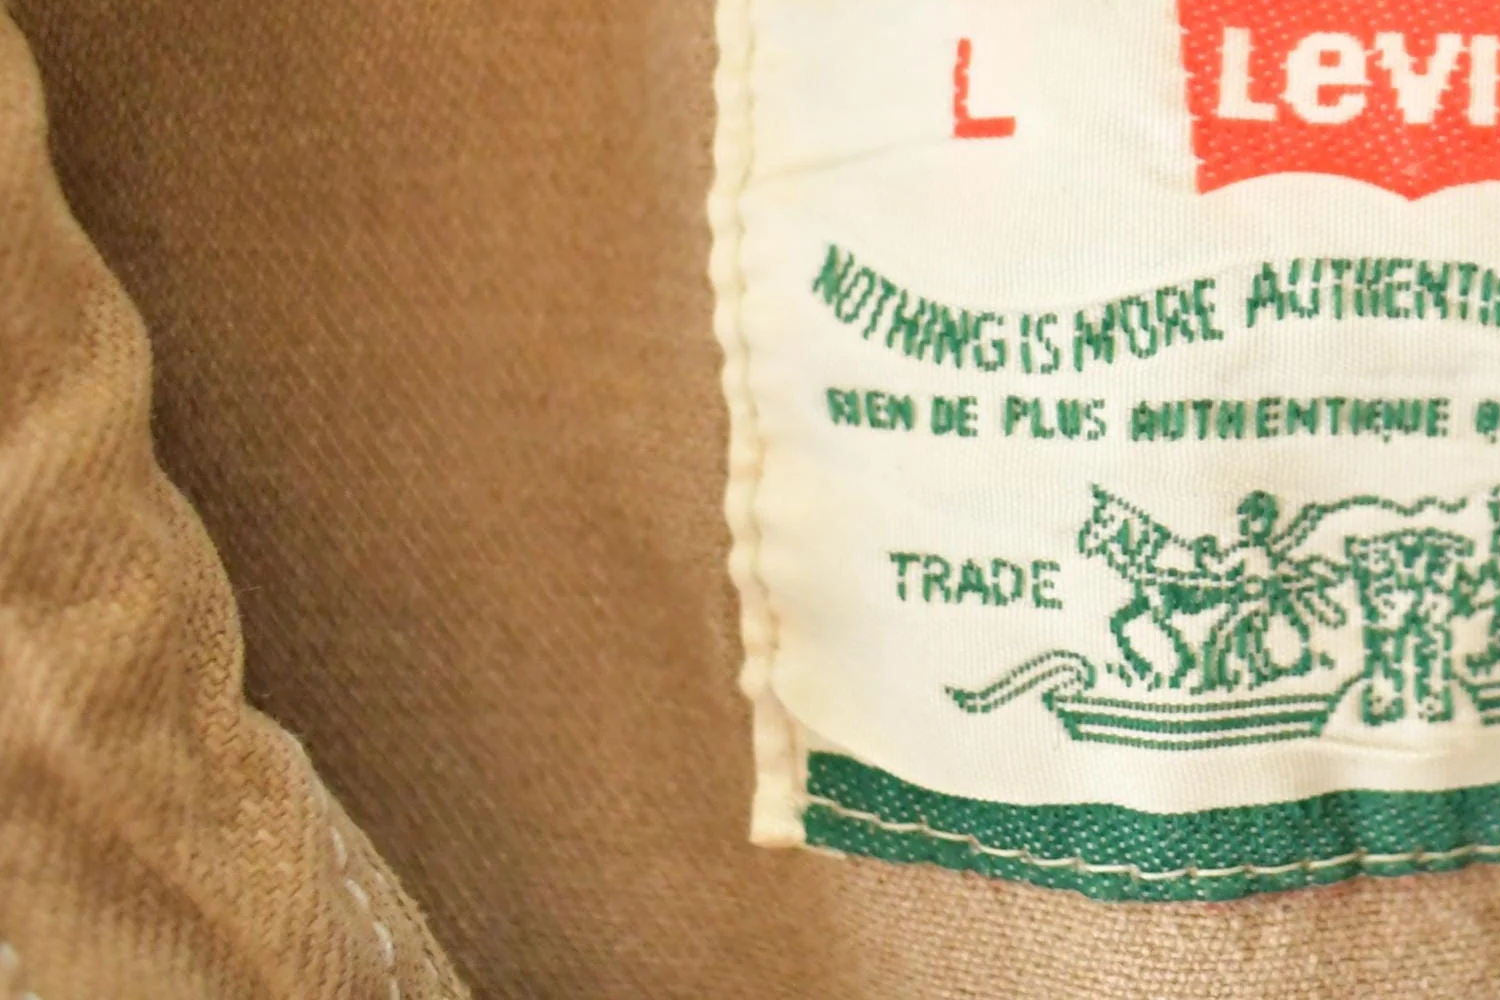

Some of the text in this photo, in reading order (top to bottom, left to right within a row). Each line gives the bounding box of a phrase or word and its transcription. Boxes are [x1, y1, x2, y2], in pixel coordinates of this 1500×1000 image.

[953, 38, 1016, 138] L
[812, 244, 1006, 372] NOTHING
[1019, 311, 1060, 374] IS
[1072, 278, 1224, 373] MORE
[930, 394, 979, 437] DE
[1004, 394, 1107, 441] PLUS
[888, 550, 1064, 610] TRADE
